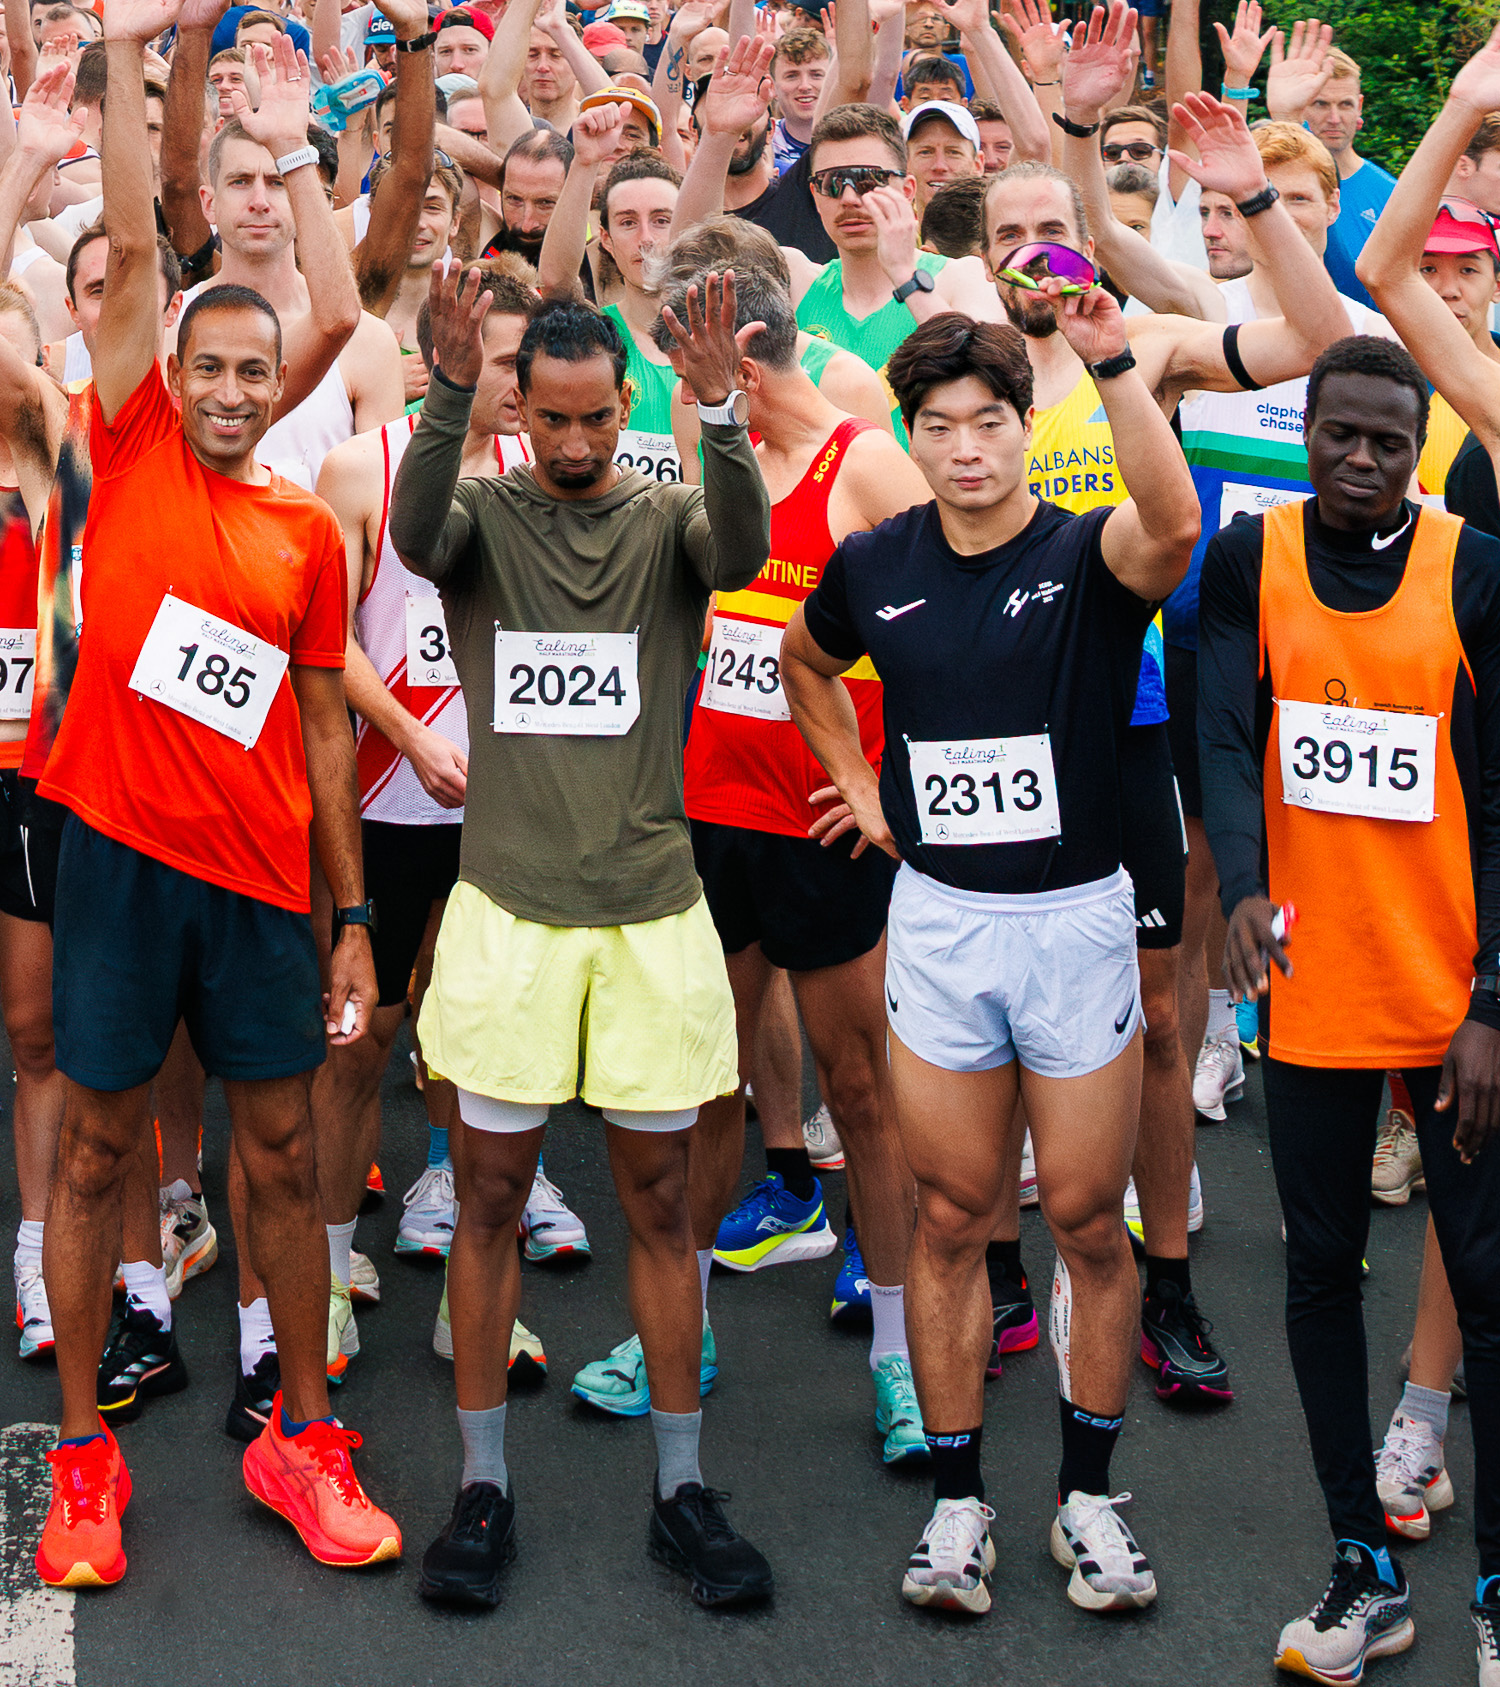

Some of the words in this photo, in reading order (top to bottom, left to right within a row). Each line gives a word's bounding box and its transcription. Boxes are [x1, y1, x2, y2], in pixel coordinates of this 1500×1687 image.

[814, 441, 840, 483] soar
[1028, 446, 1115, 476] ALBANS
[1029, 473, 1115, 499] RIDERS
[200, 617, 257, 656] Ealing
[537, 640, 598, 657] Ealing
[178, 644, 257, 709] 185
[509, 664, 626, 705] 2024
[711, 646, 780, 694] 1243
[1322, 713, 1389, 736] Ealing
[941, 746, 1008, 764] Ealing
[1292, 735, 1418, 791] 3915
[925, 769, 1043, 816] 2313
[1073, 1410, 1123, 1430] cep
[926, 1434, 971, 1448] cep
